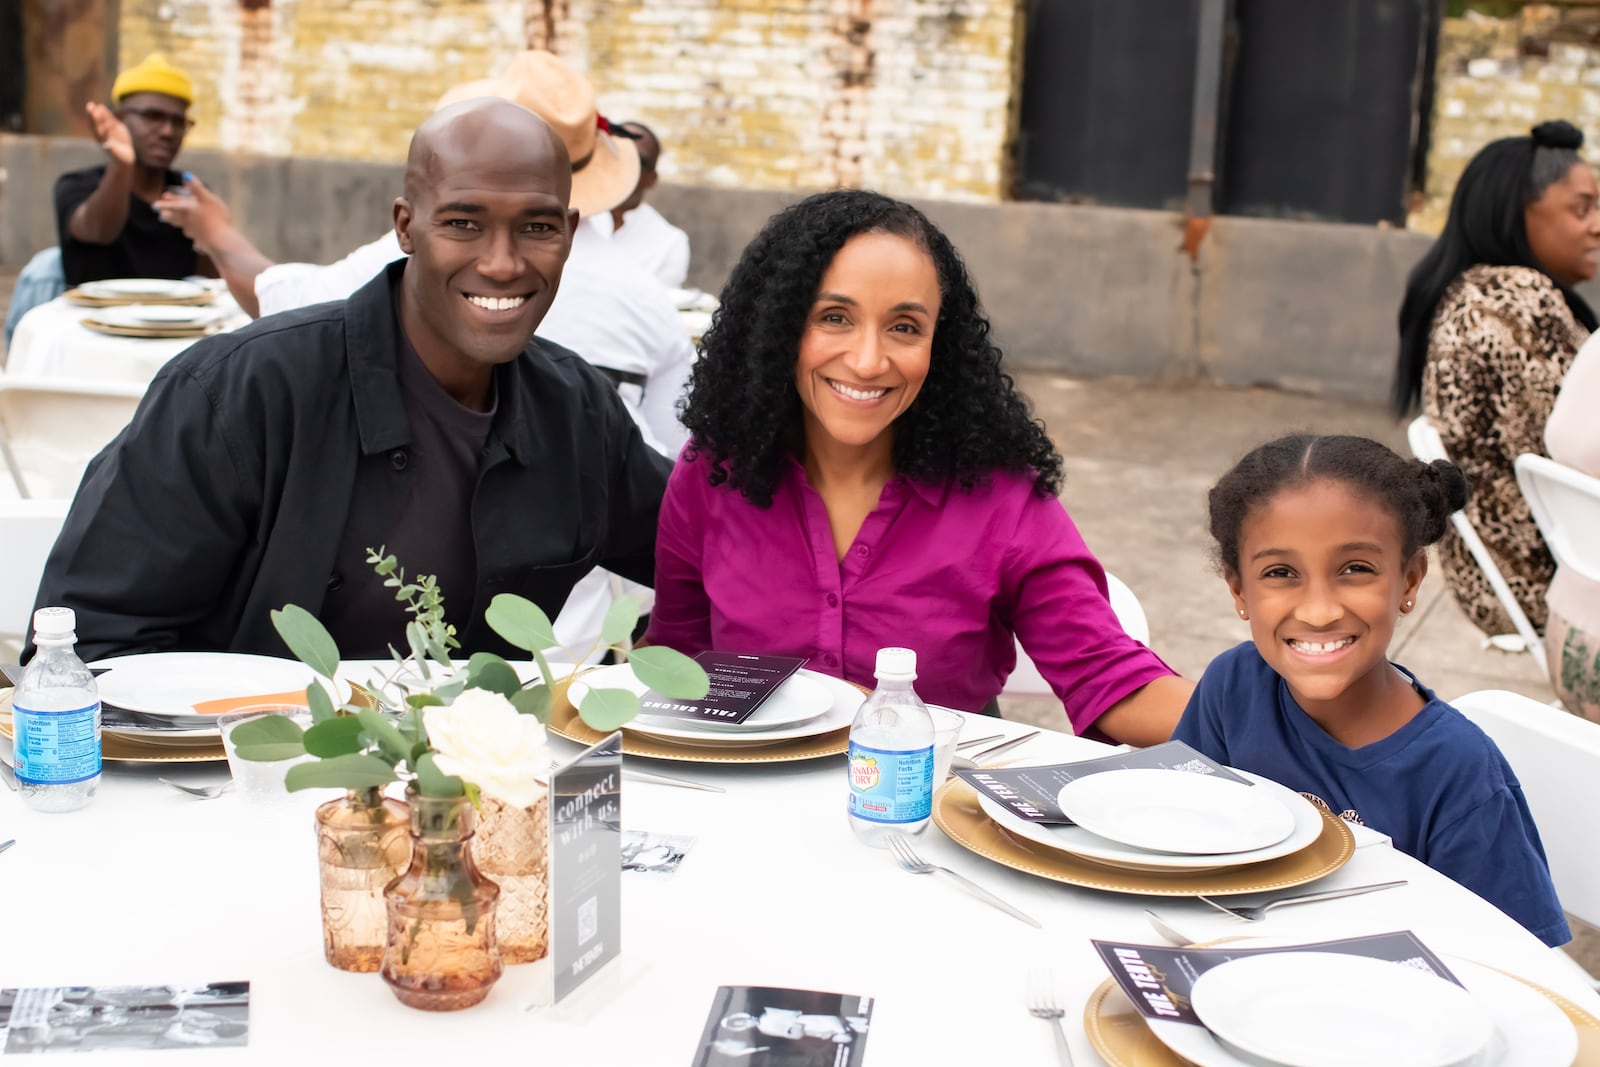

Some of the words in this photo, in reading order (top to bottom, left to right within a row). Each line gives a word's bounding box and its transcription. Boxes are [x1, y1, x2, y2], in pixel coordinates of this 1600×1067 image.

[642, 700, 698, 713] SALONS
[703, 707, 738, 717] FALL
[850, 763, 880, 777] CANADA
[855, 775, 872, 785] DRY
[972, 773, 1019, 799] TENTH
[557, 773, 615, 822] connect
[1011, 801, 1045, 818] THE
[560, 806, 593, 847] with
[598, 800, 617, 823] us.
[1113, 947, 1161, 989] TENTH
[1143, 992, 1181, 1017] THE
